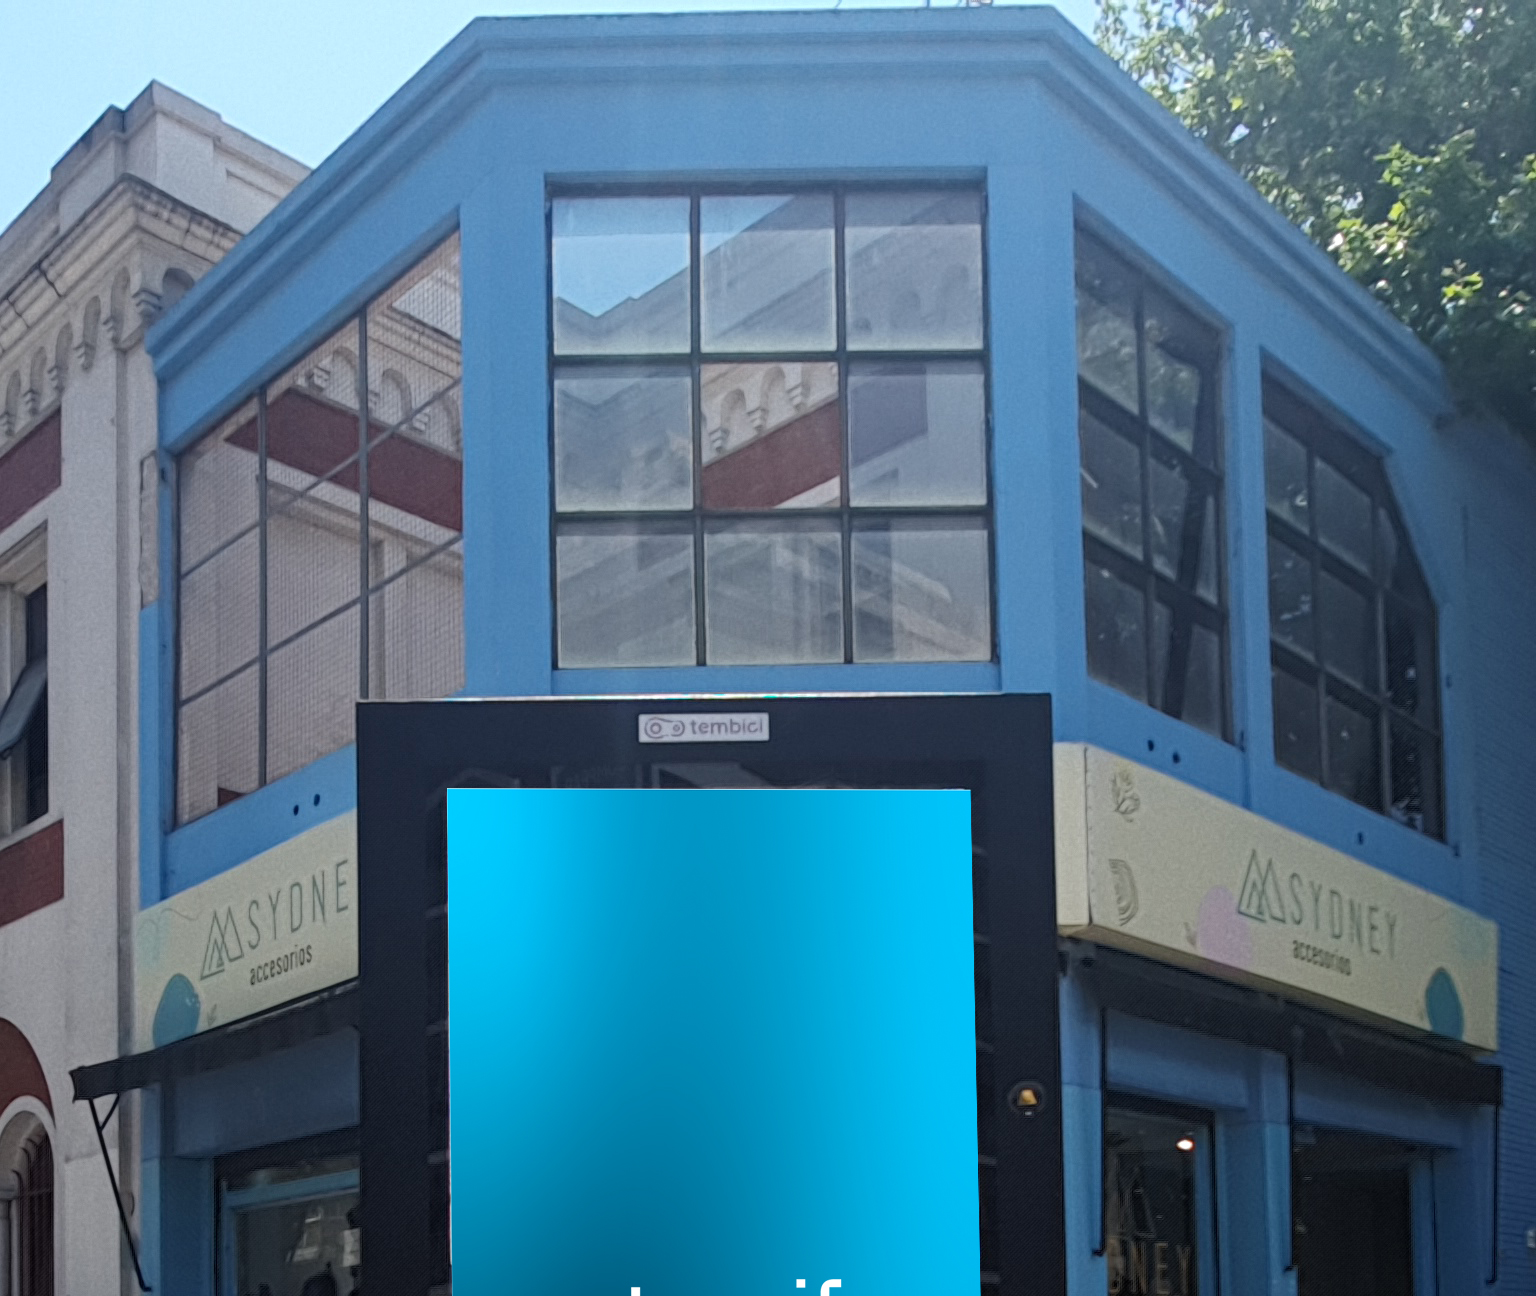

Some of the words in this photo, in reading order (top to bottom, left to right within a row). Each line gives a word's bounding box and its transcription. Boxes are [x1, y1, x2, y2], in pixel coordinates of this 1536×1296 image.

[690, 718, 763, 735] tembici
[248, 859, 349, 950] SYDNE
[1289, 872, 1397, 960] SYDNEY
[250, 944, 313, 986] accesorios
